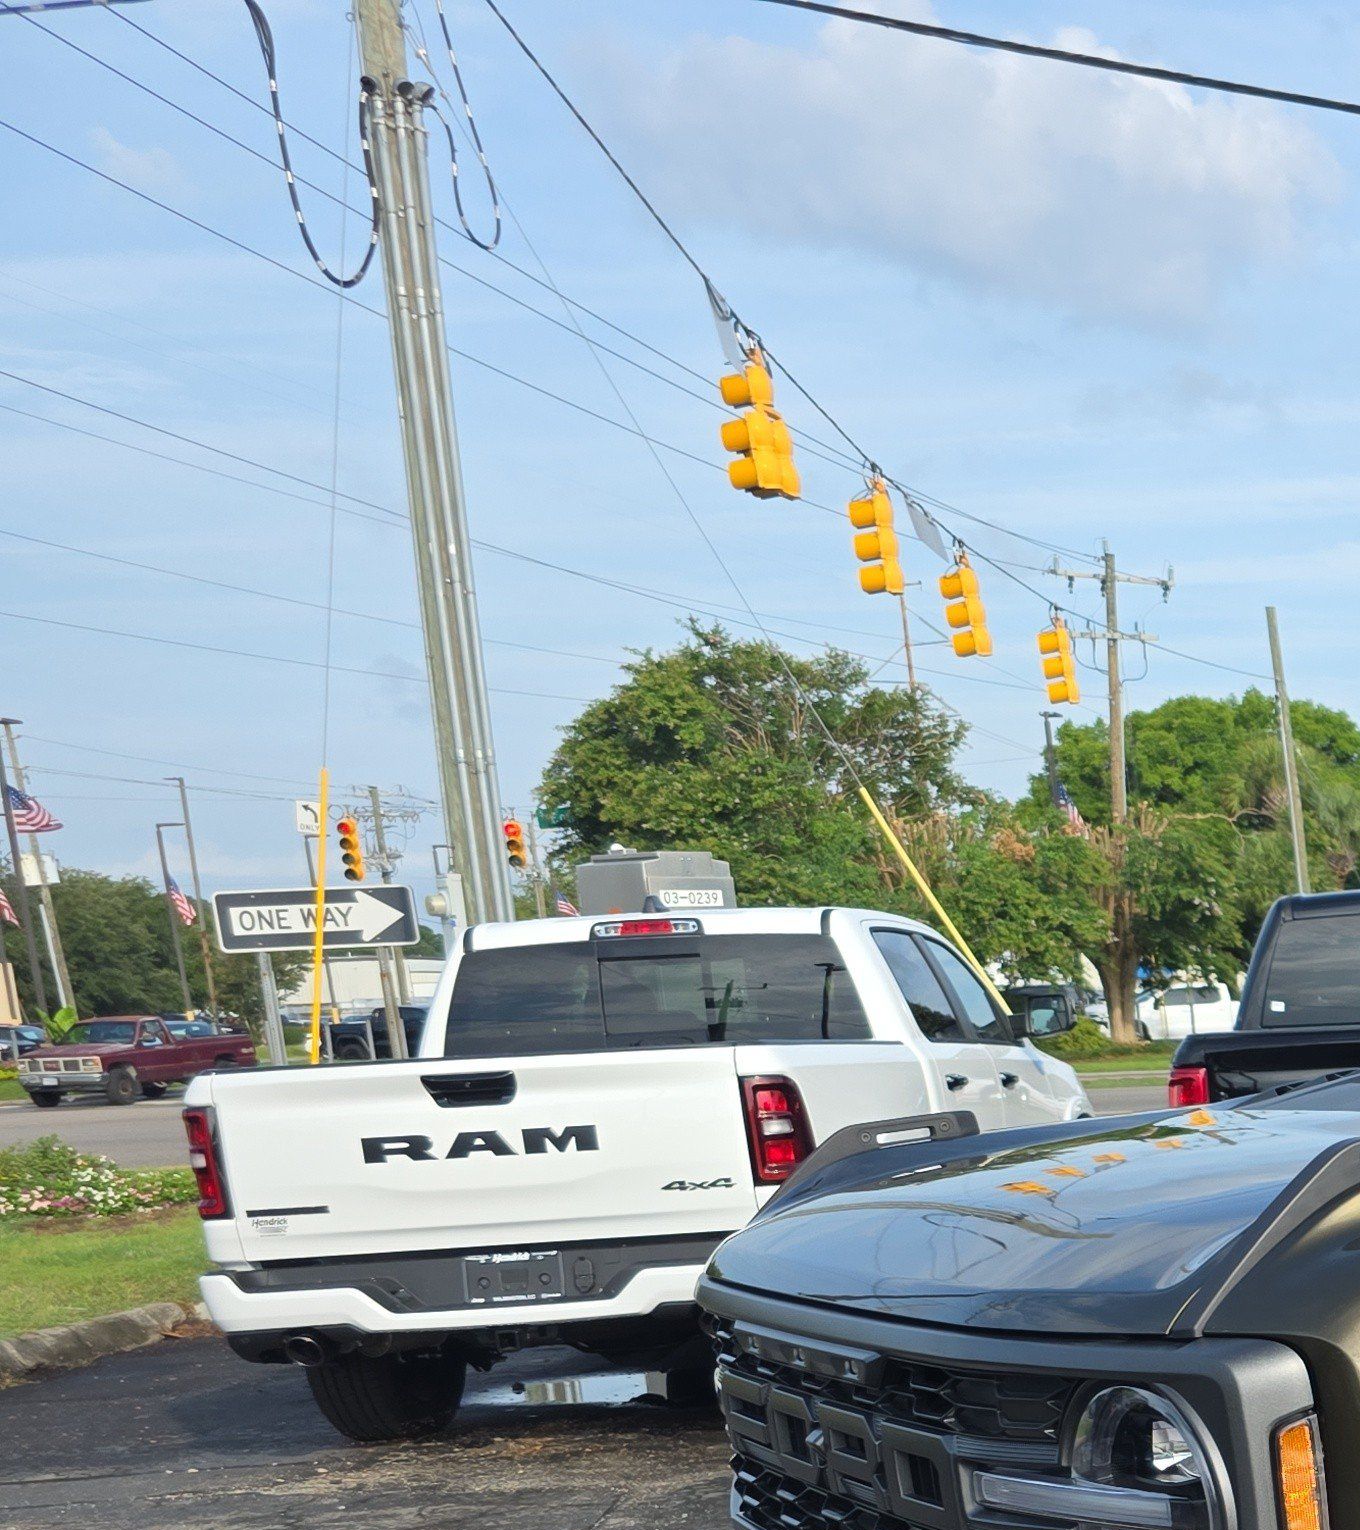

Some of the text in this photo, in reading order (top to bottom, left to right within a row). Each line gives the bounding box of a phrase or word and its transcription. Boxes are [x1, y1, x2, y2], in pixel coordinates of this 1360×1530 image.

[299, 823, 319, 831] ONLY
[663, 892, 719, 905] 03-0239
[238, 905, 354, 931] ONE WAY
[360, 1124, 600, 1165] RAM
[660, 1177, 737, 1192] 4x4
